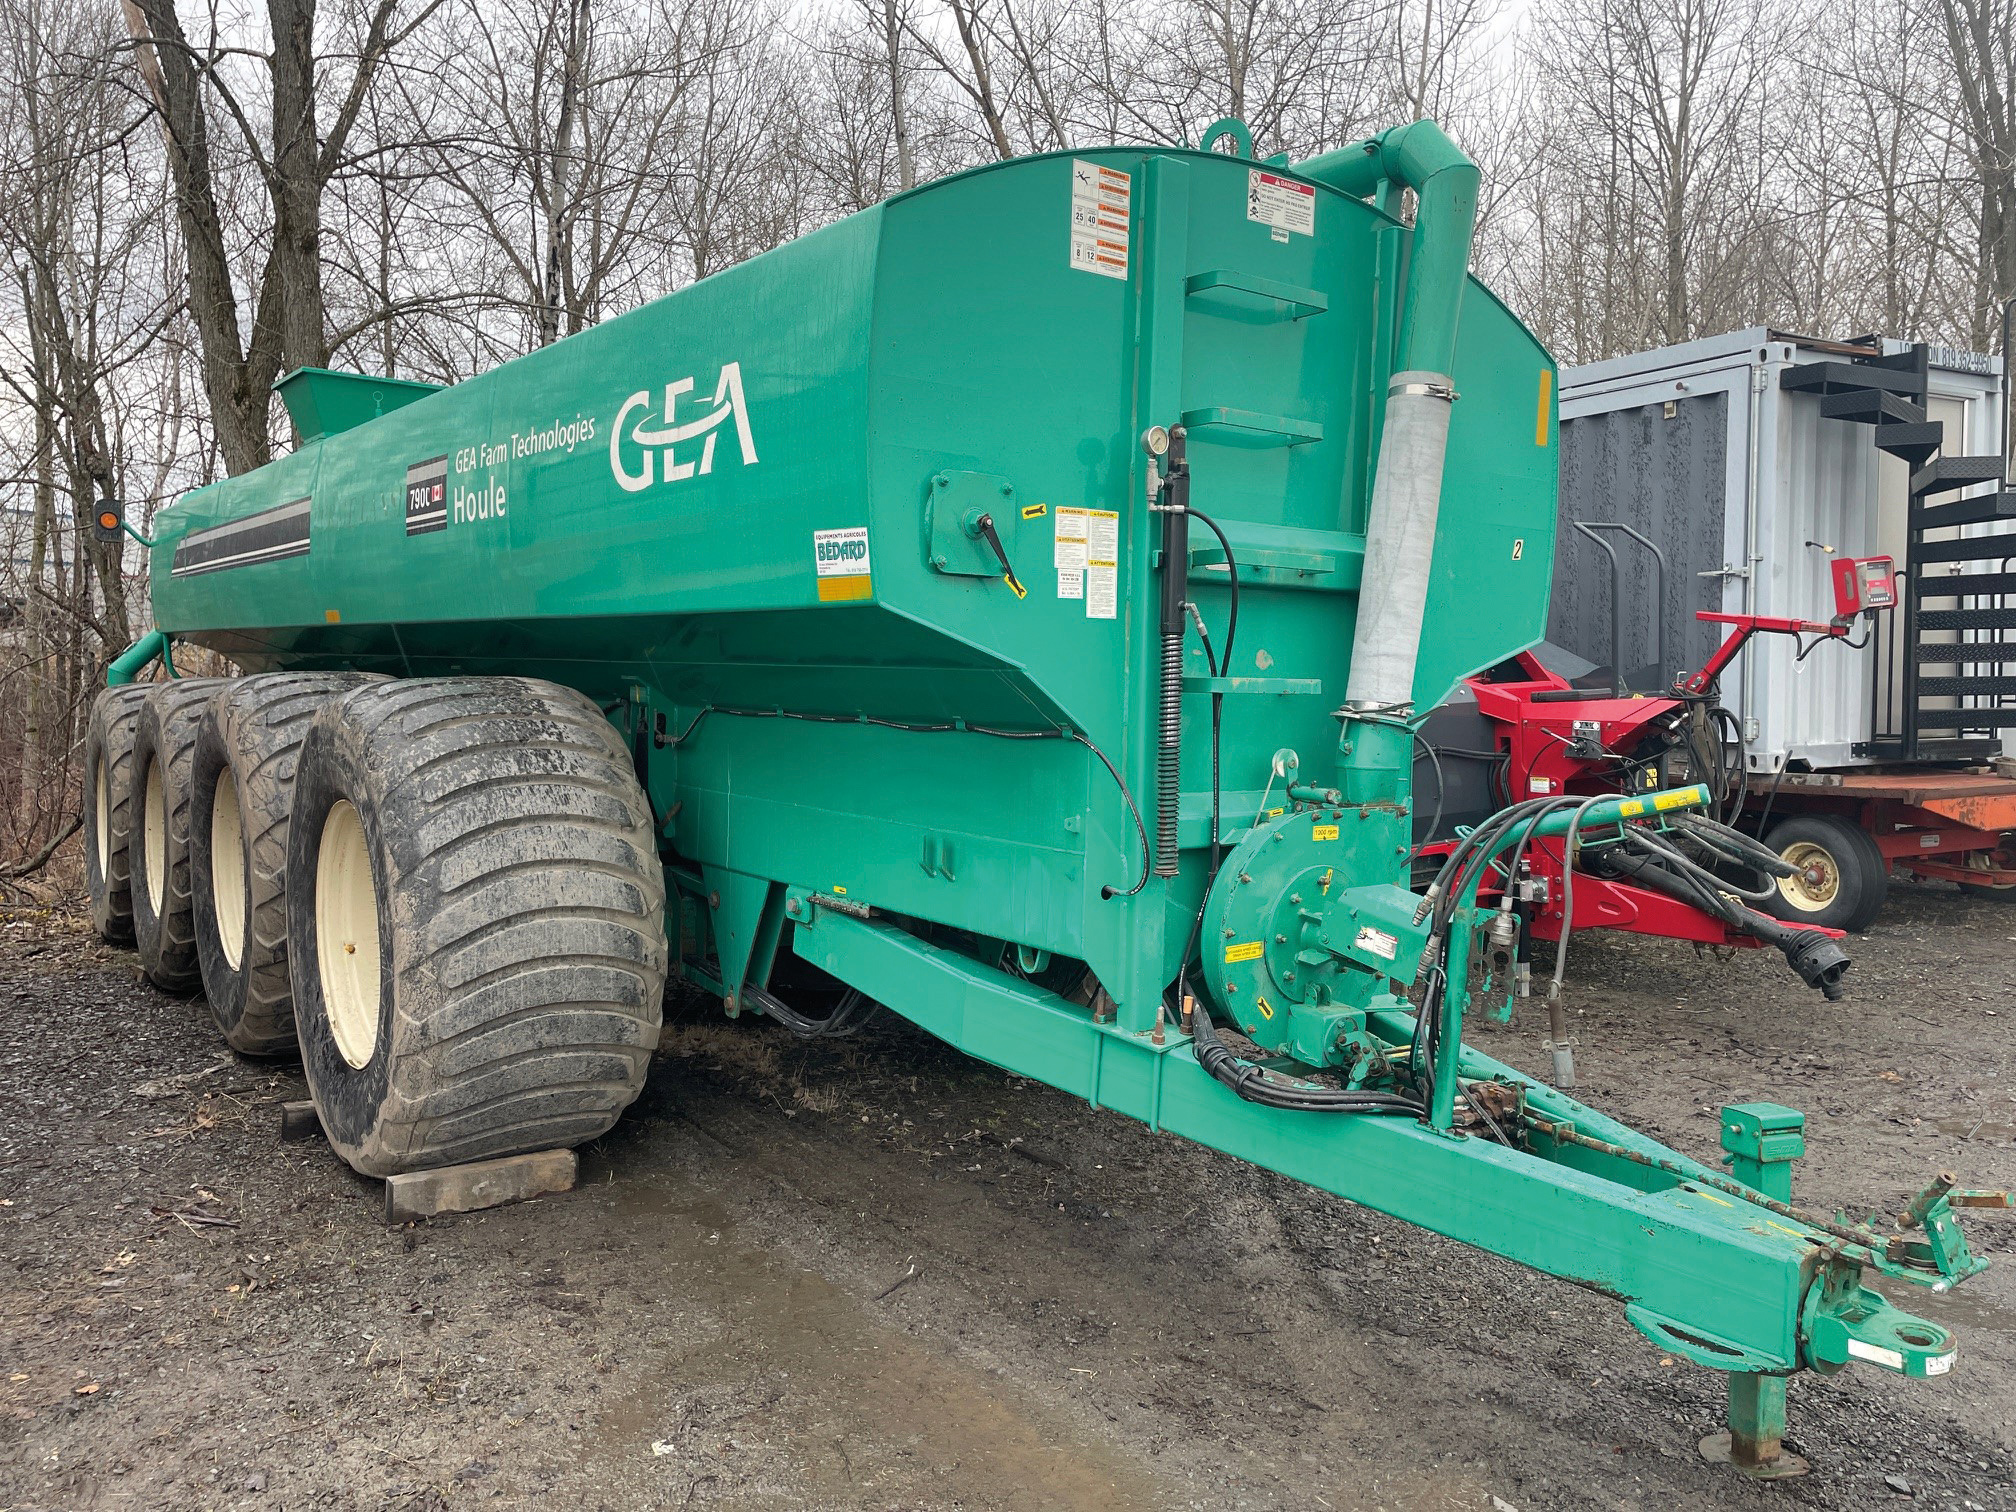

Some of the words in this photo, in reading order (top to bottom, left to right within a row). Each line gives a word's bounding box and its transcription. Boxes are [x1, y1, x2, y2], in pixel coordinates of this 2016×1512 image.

[1281, 181, 1301, 191] DANGER
[1076, 212, 1084, 221] 25
[1088, 215, 1095, 224] 40
[1087, 252, 1094, 260] 12
[1942, 347, 1956, 368] 819
[610, 361, 759, 492] GEA
[455, 446, 477, 474] GEA
[480, 442, 507, 468] Farm
[511, 413, 595, 460] Technologies
[454, 475, 506, 524] Houle
[1514, 541, 1521, 558] 2
